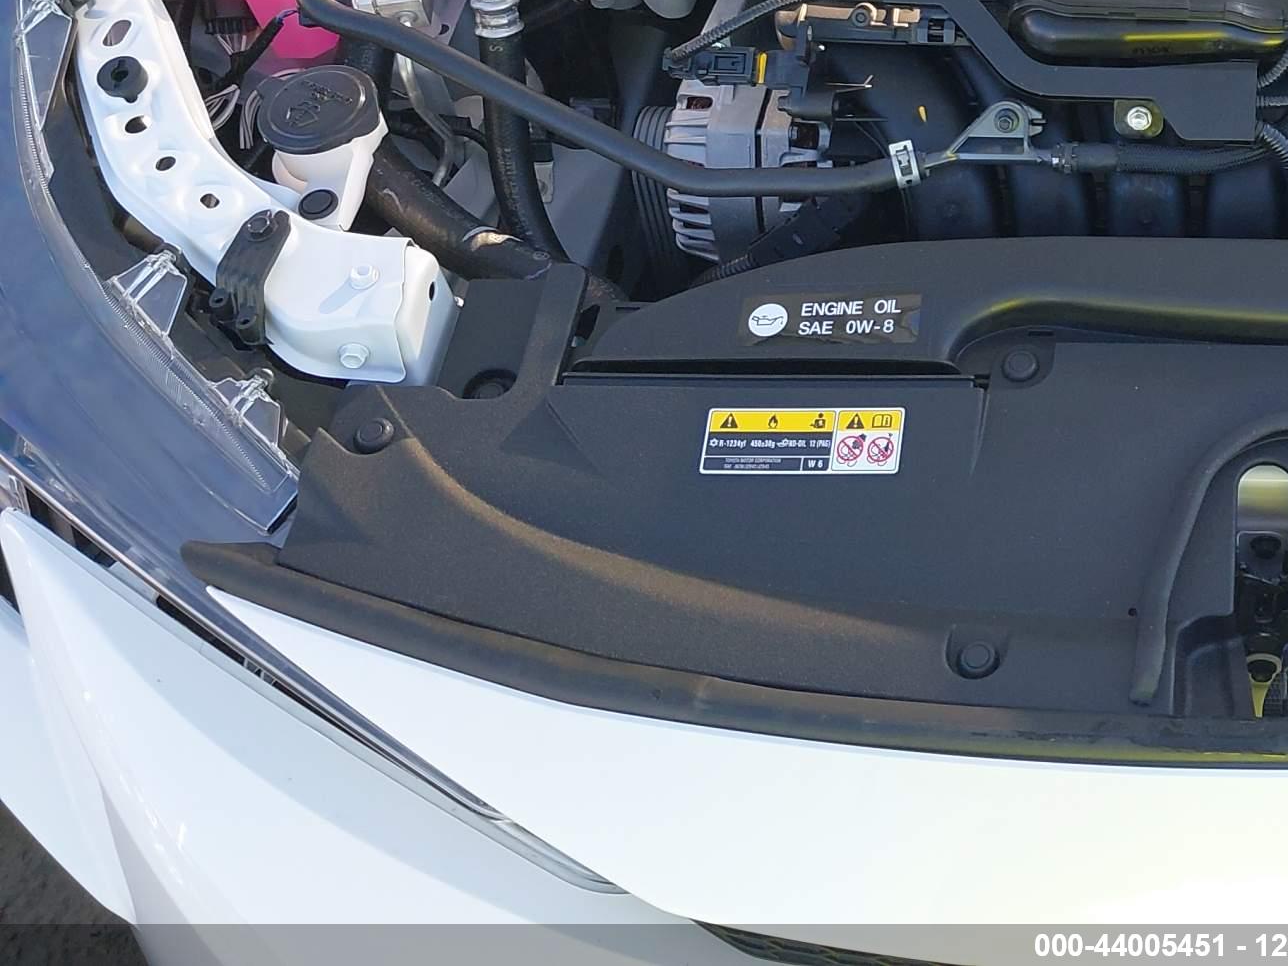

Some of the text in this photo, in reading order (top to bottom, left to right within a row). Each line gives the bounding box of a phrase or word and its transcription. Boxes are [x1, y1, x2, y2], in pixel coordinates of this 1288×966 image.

[801, 299, 902, 317] ENGINE OIL
[798, 319, 895, 335] SAE 0W-8
[718, 439, 746, 449] R-1234yf
[807, 460, 816, 468] W
